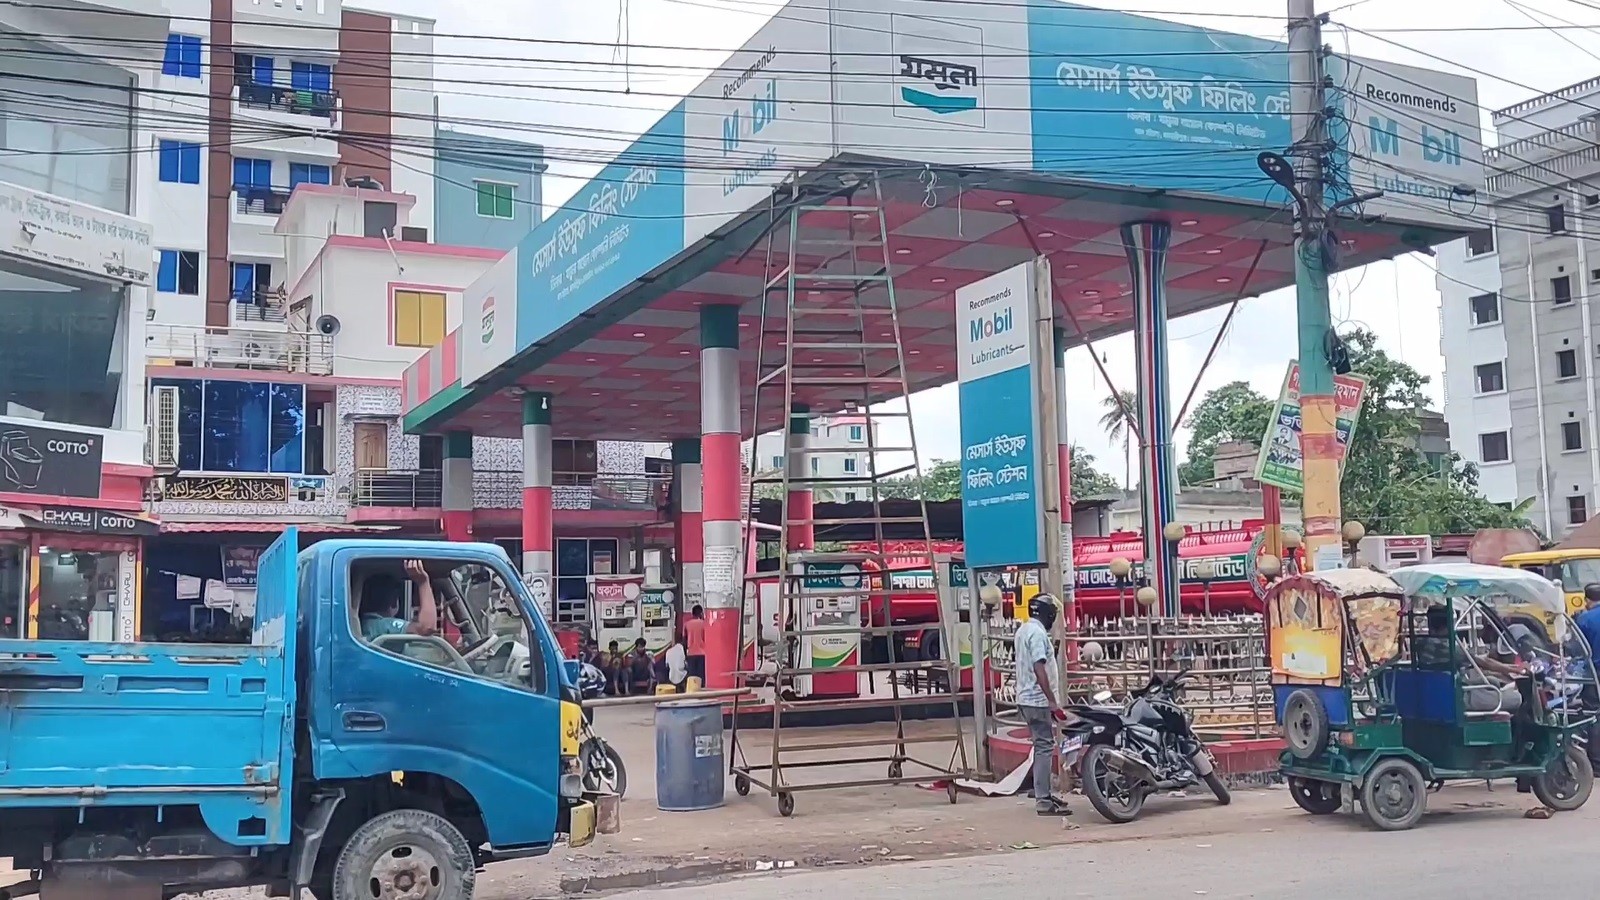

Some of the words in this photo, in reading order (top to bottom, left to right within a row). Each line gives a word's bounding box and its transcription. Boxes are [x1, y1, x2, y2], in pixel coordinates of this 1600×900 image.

[723, 44, 776, 99] Recommends
[900, 55, 977, 90] যমুনা
[1056, 61, 1120, 94] মেসার্স
[1127, 66, 1193, 112] ইউসুফ
[1199, 75, 1258, 119] ফিলিং
[1366, 83, 1457, 113] Recommends
[532, 231, 556, 277] মেসার্স
[558, 212, 587, 258] ইউসুফ
[588, 183, 618, 234] ফিলিং
[969, 287, 1012, 310] Recommends
[970, 307, 1013, 342] Mobil
[971, 344, 1014, 365] Lubricants
[47, 439, 89, 455] COTTO
[966, 437, 993, 460] মেসার্স
[995, 434, 1026, 457] ইউসুফ
[967, 467, 994, 489] ফিলিং
[996, 464, 1027, 485] স্টেশন
[43, 510, 91, 523] CHARU
[101, 516, 136, 529] COTTO
[123, 572, 132, 607] CHARU
[124, 618, 132, 642] OTTO
